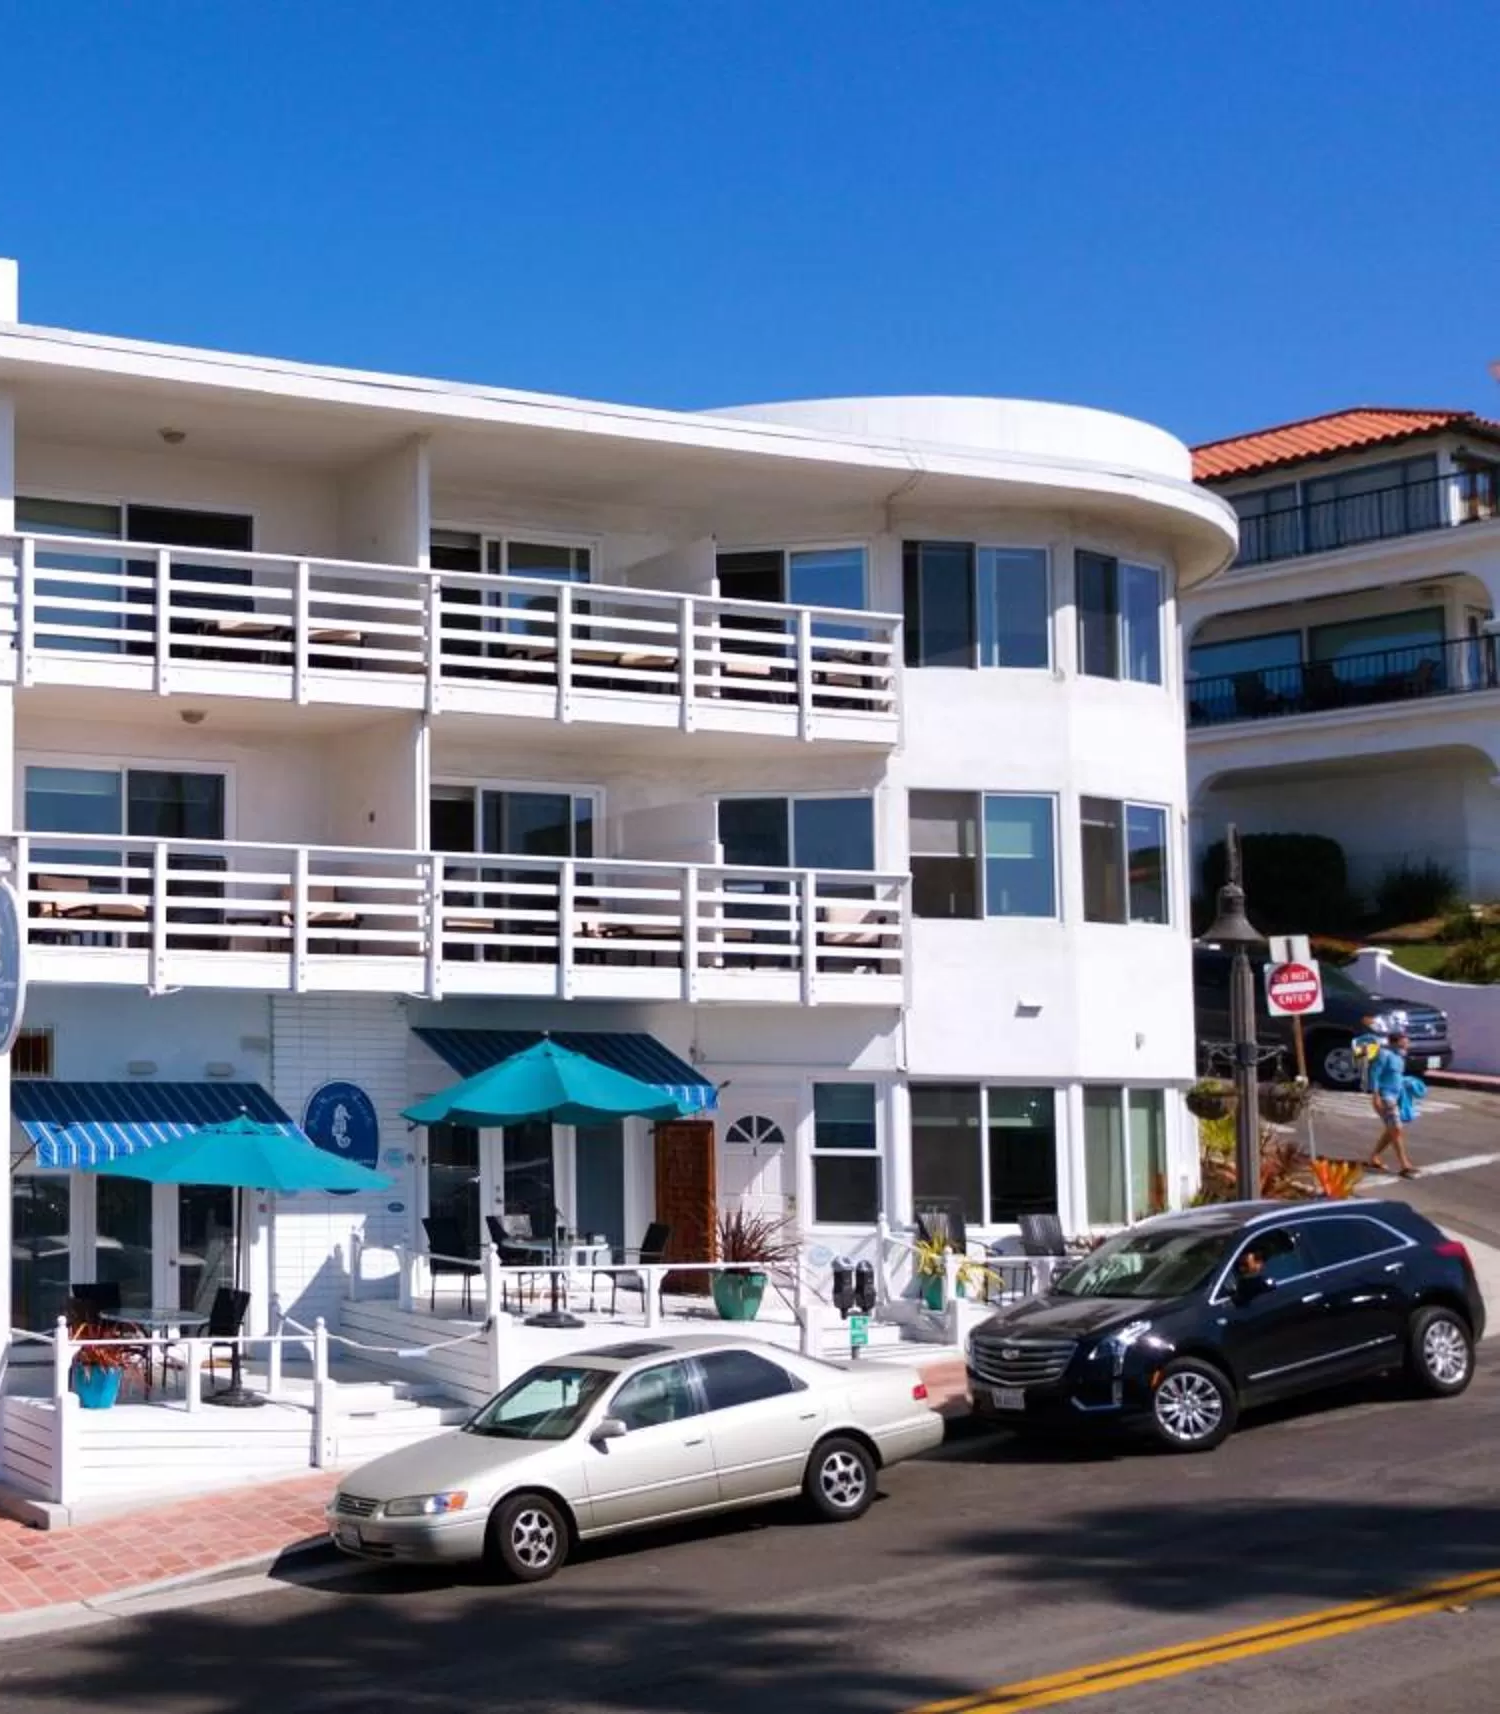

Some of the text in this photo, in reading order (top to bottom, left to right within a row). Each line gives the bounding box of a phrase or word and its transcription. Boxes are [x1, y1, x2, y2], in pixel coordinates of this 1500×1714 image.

[1273, 970, 1309, 984] DO NOT
[1277, 992, 1312, 1006] ENTER
